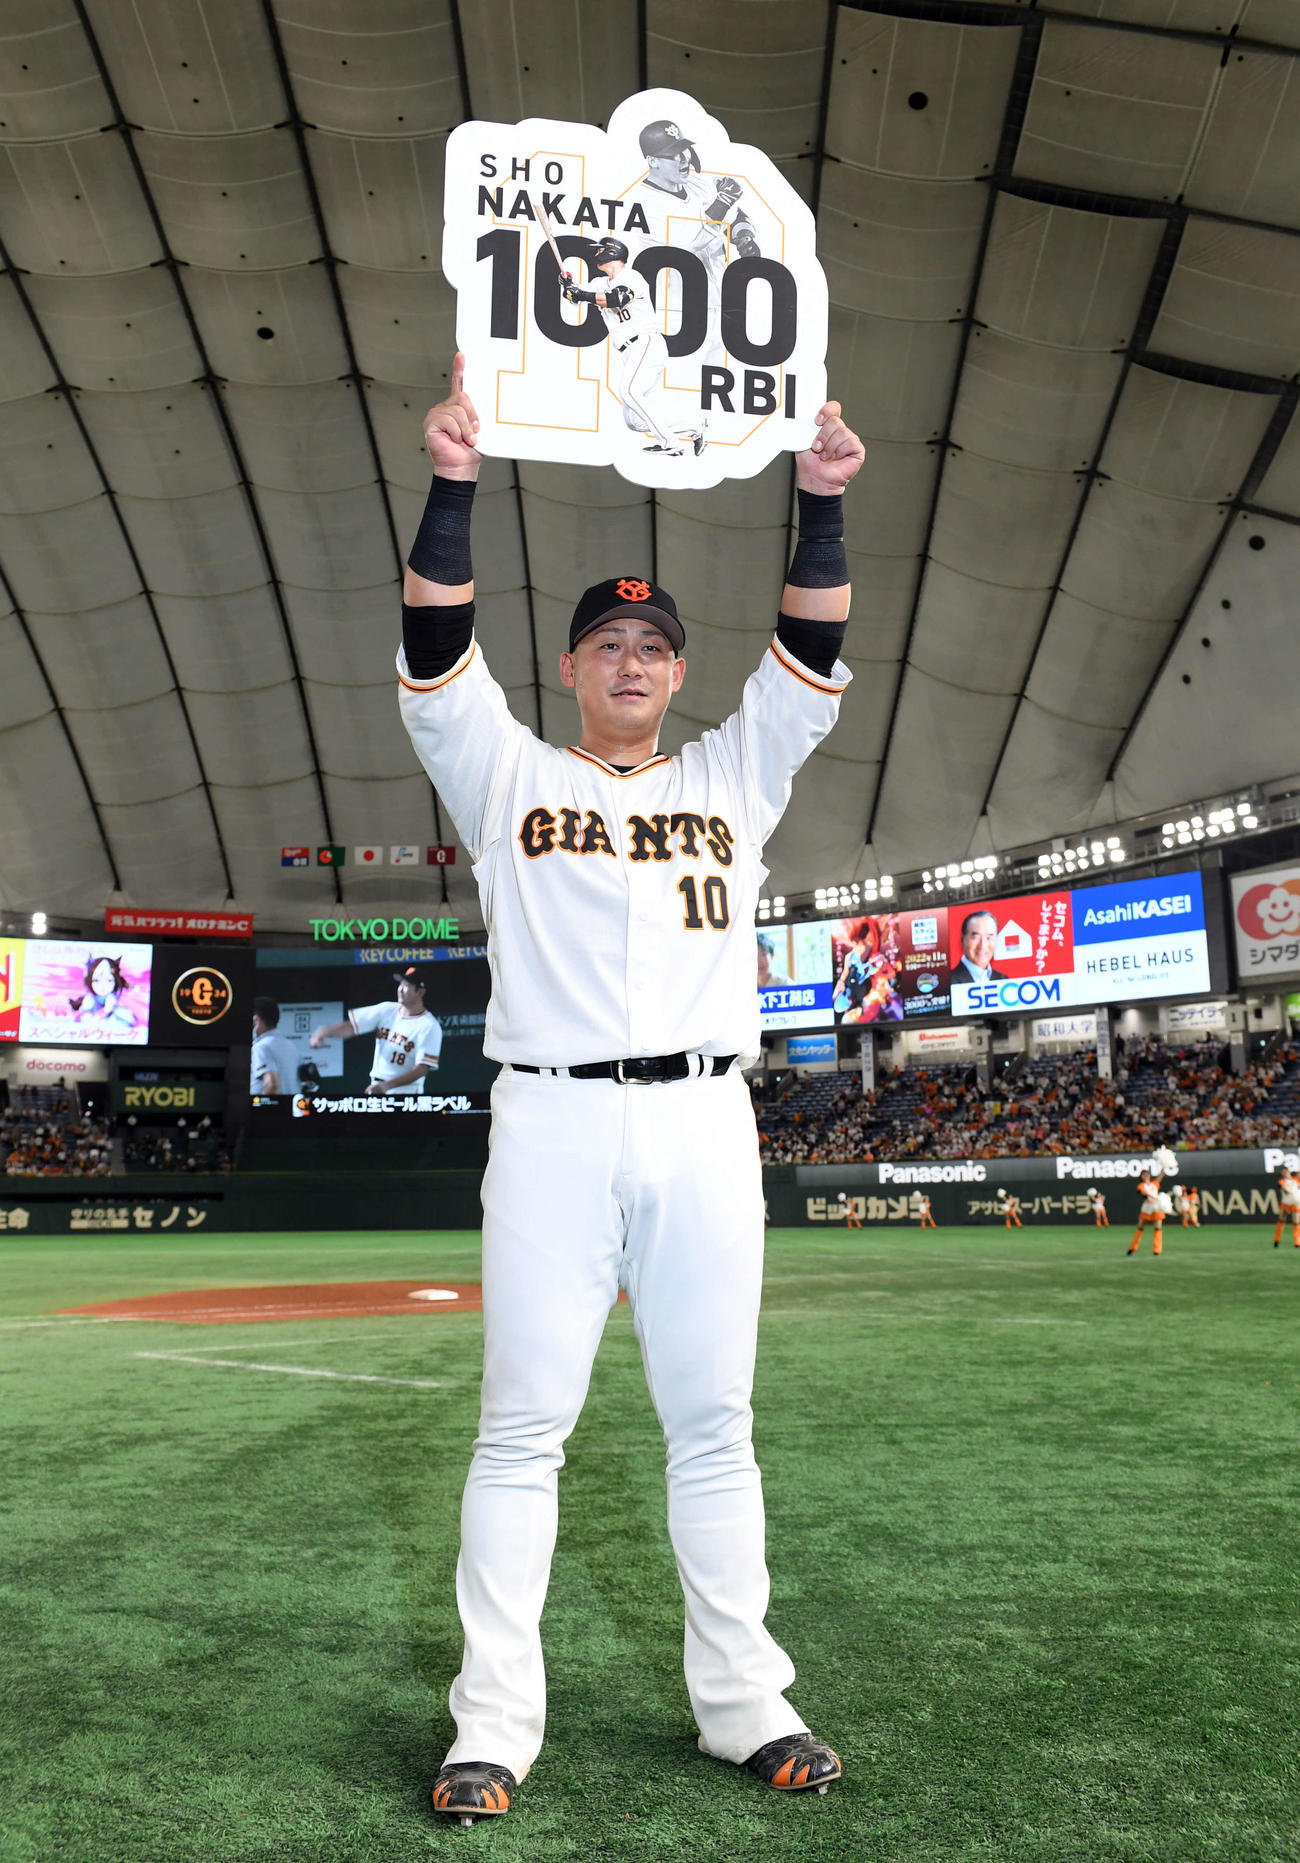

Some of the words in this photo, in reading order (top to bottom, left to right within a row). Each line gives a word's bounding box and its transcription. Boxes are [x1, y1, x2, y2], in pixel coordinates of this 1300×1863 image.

[480, 153, 564, 185] SHO
[478, 185, 650, 235] NAKATA
[476, 228, 797, 367] 1000
[617, 308, 632, 323] 10
[701, 364, 797, 419] RBI
[518, 807, 735, 868] GIANTS
[678, 875, 730, 931] 10
[309, 918, 390, 941] TOKYO
[392, 918, 460, 940] DOME
[1087, 954, 1142, 974] HEBEL
[1147, 948, 1195, 968] HAUS
[192, 977, 213, 1006] G
[967, 978, 1061, 1010] SECOM
[26, 1058, 87, 1073] docomo
[390, 1051, 406, 1066] 18
[124, 1086, 195, 1107] RYOBI
[878, 1160, 987, 1185] Panasonic
[1055, 1156, 1180, 1180] Panason
[133, 1206, 207, 1228] セノン
